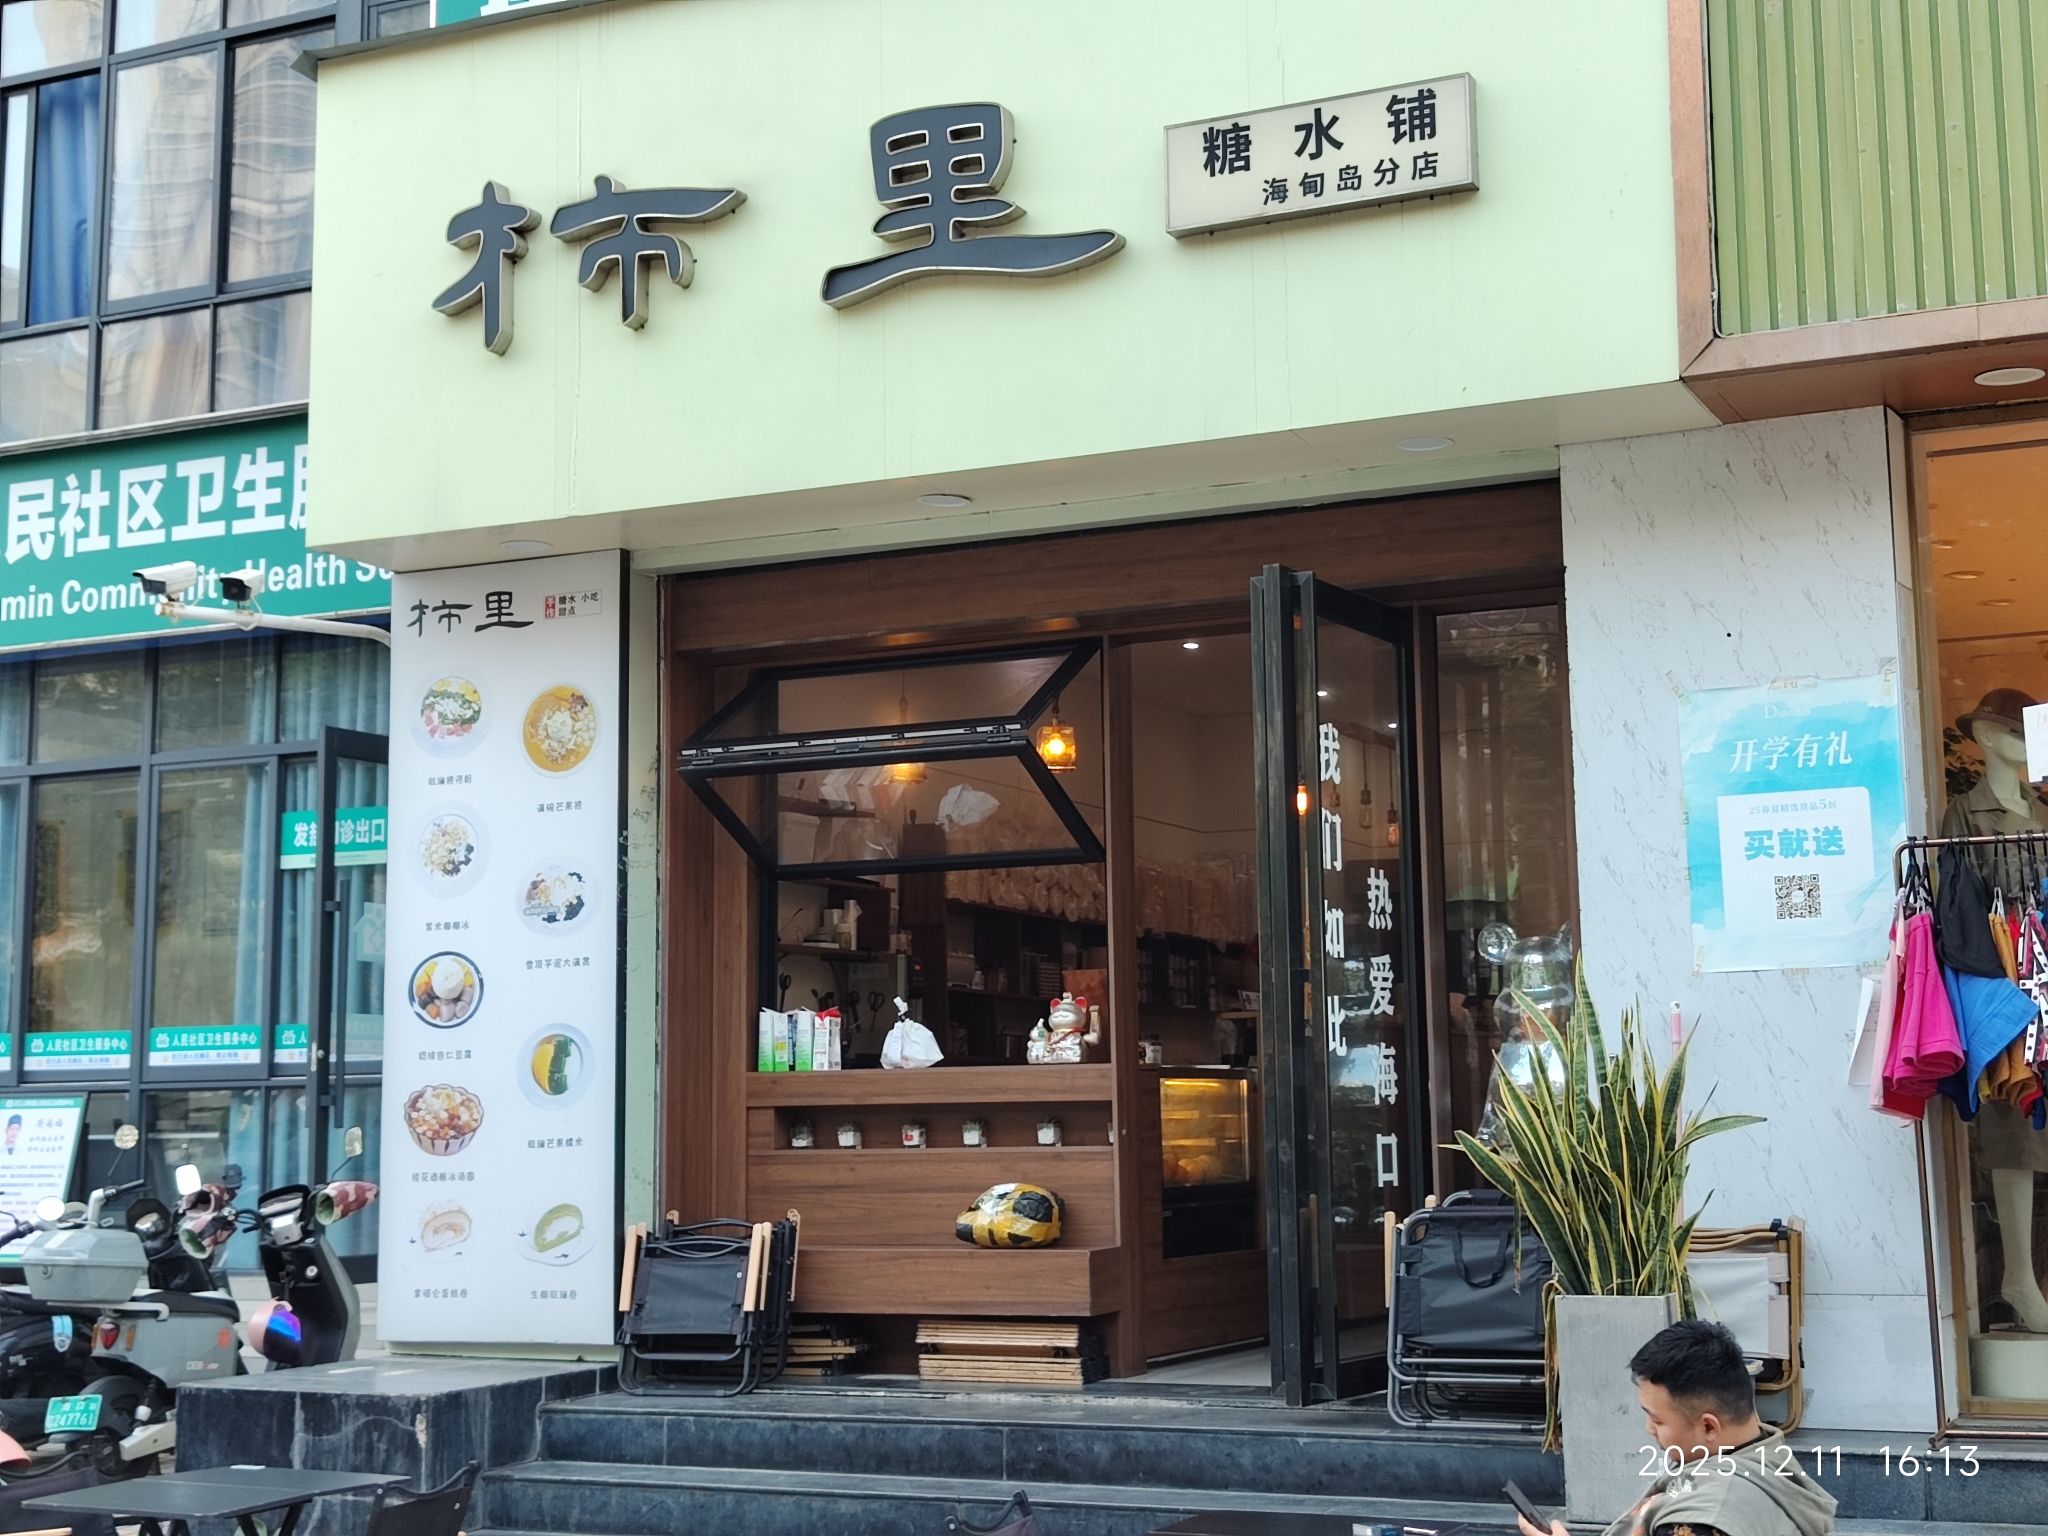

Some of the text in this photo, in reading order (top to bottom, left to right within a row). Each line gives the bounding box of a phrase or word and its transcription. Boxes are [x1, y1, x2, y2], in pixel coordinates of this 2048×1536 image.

[1202, 88, 1437, 177] 糖水铺
[1262, 151, 1439, 206] 海甸岛分店
[432, 101, 1126, 356] 柿里
[406, 591, 534, 638] 柿里
[581, 591, 600, 603] 小吃
[1728, 730, 1853, 773] 开学有礼
[1743, 825, 1846, 861] 买就送
[1319, 722, 1347, 1057] 我们如此
[45, 1037, 128, 1052] 人民社区卫生服务中心
[171, 1031, 257, 1047] 人民社区卫生服务中心
[1367, 867, 1398, 1187] 热爱海口
